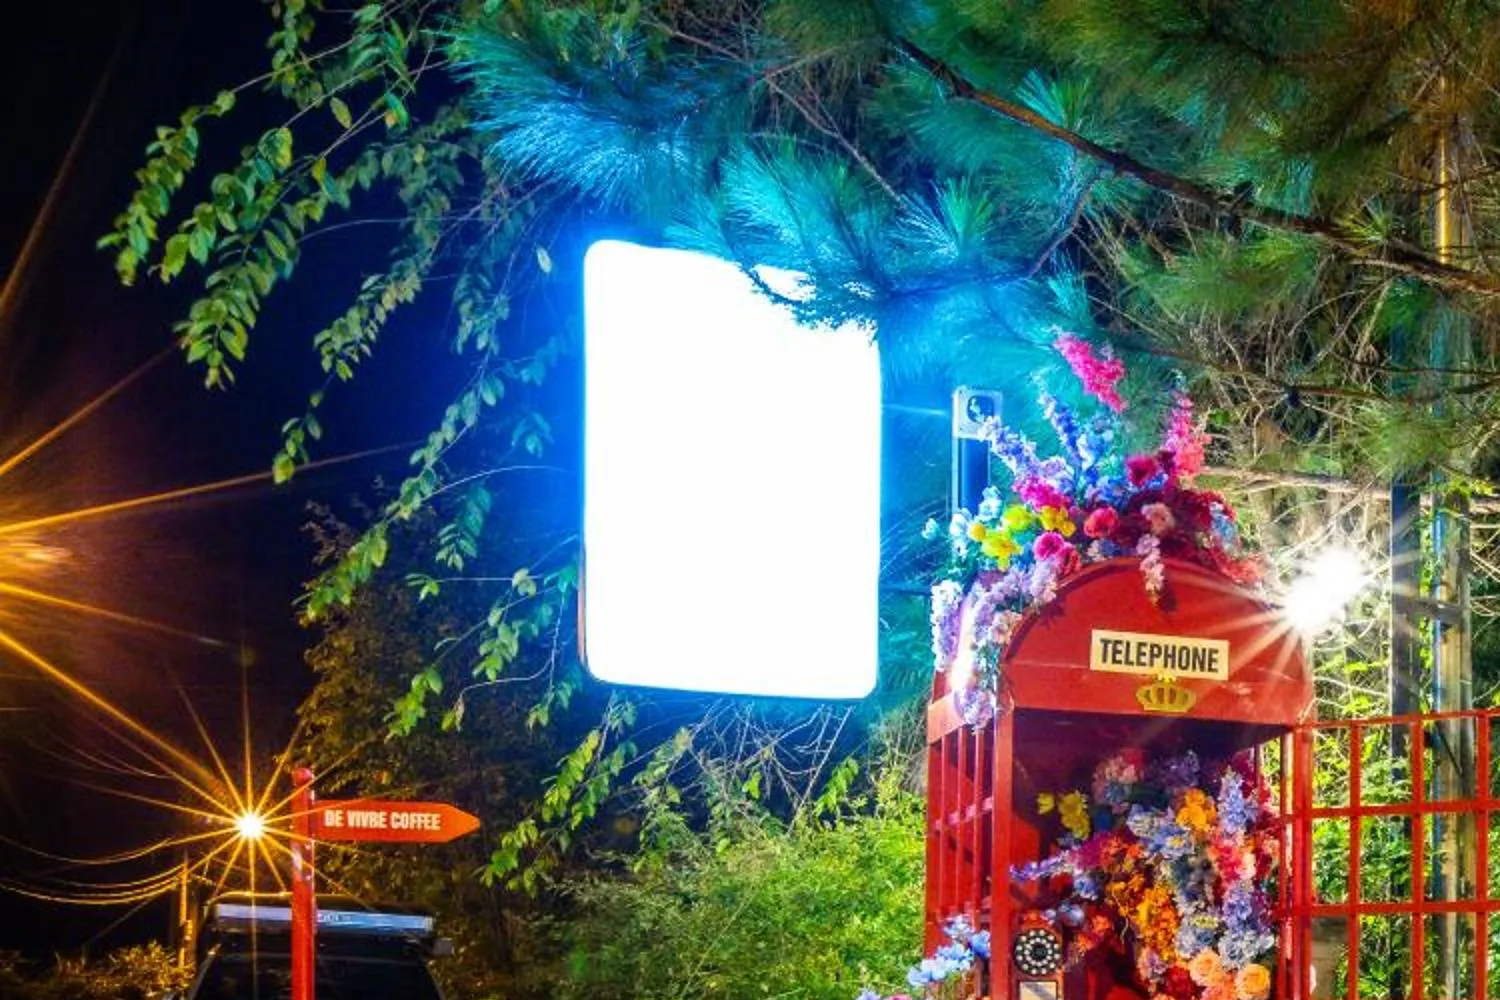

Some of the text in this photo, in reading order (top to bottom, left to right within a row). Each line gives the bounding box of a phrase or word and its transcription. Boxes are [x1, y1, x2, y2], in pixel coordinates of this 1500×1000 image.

[1100, 638, 1219, 673] TELEPHONE
[324, 809, 441, 830] DE VIVRE COFFEE
